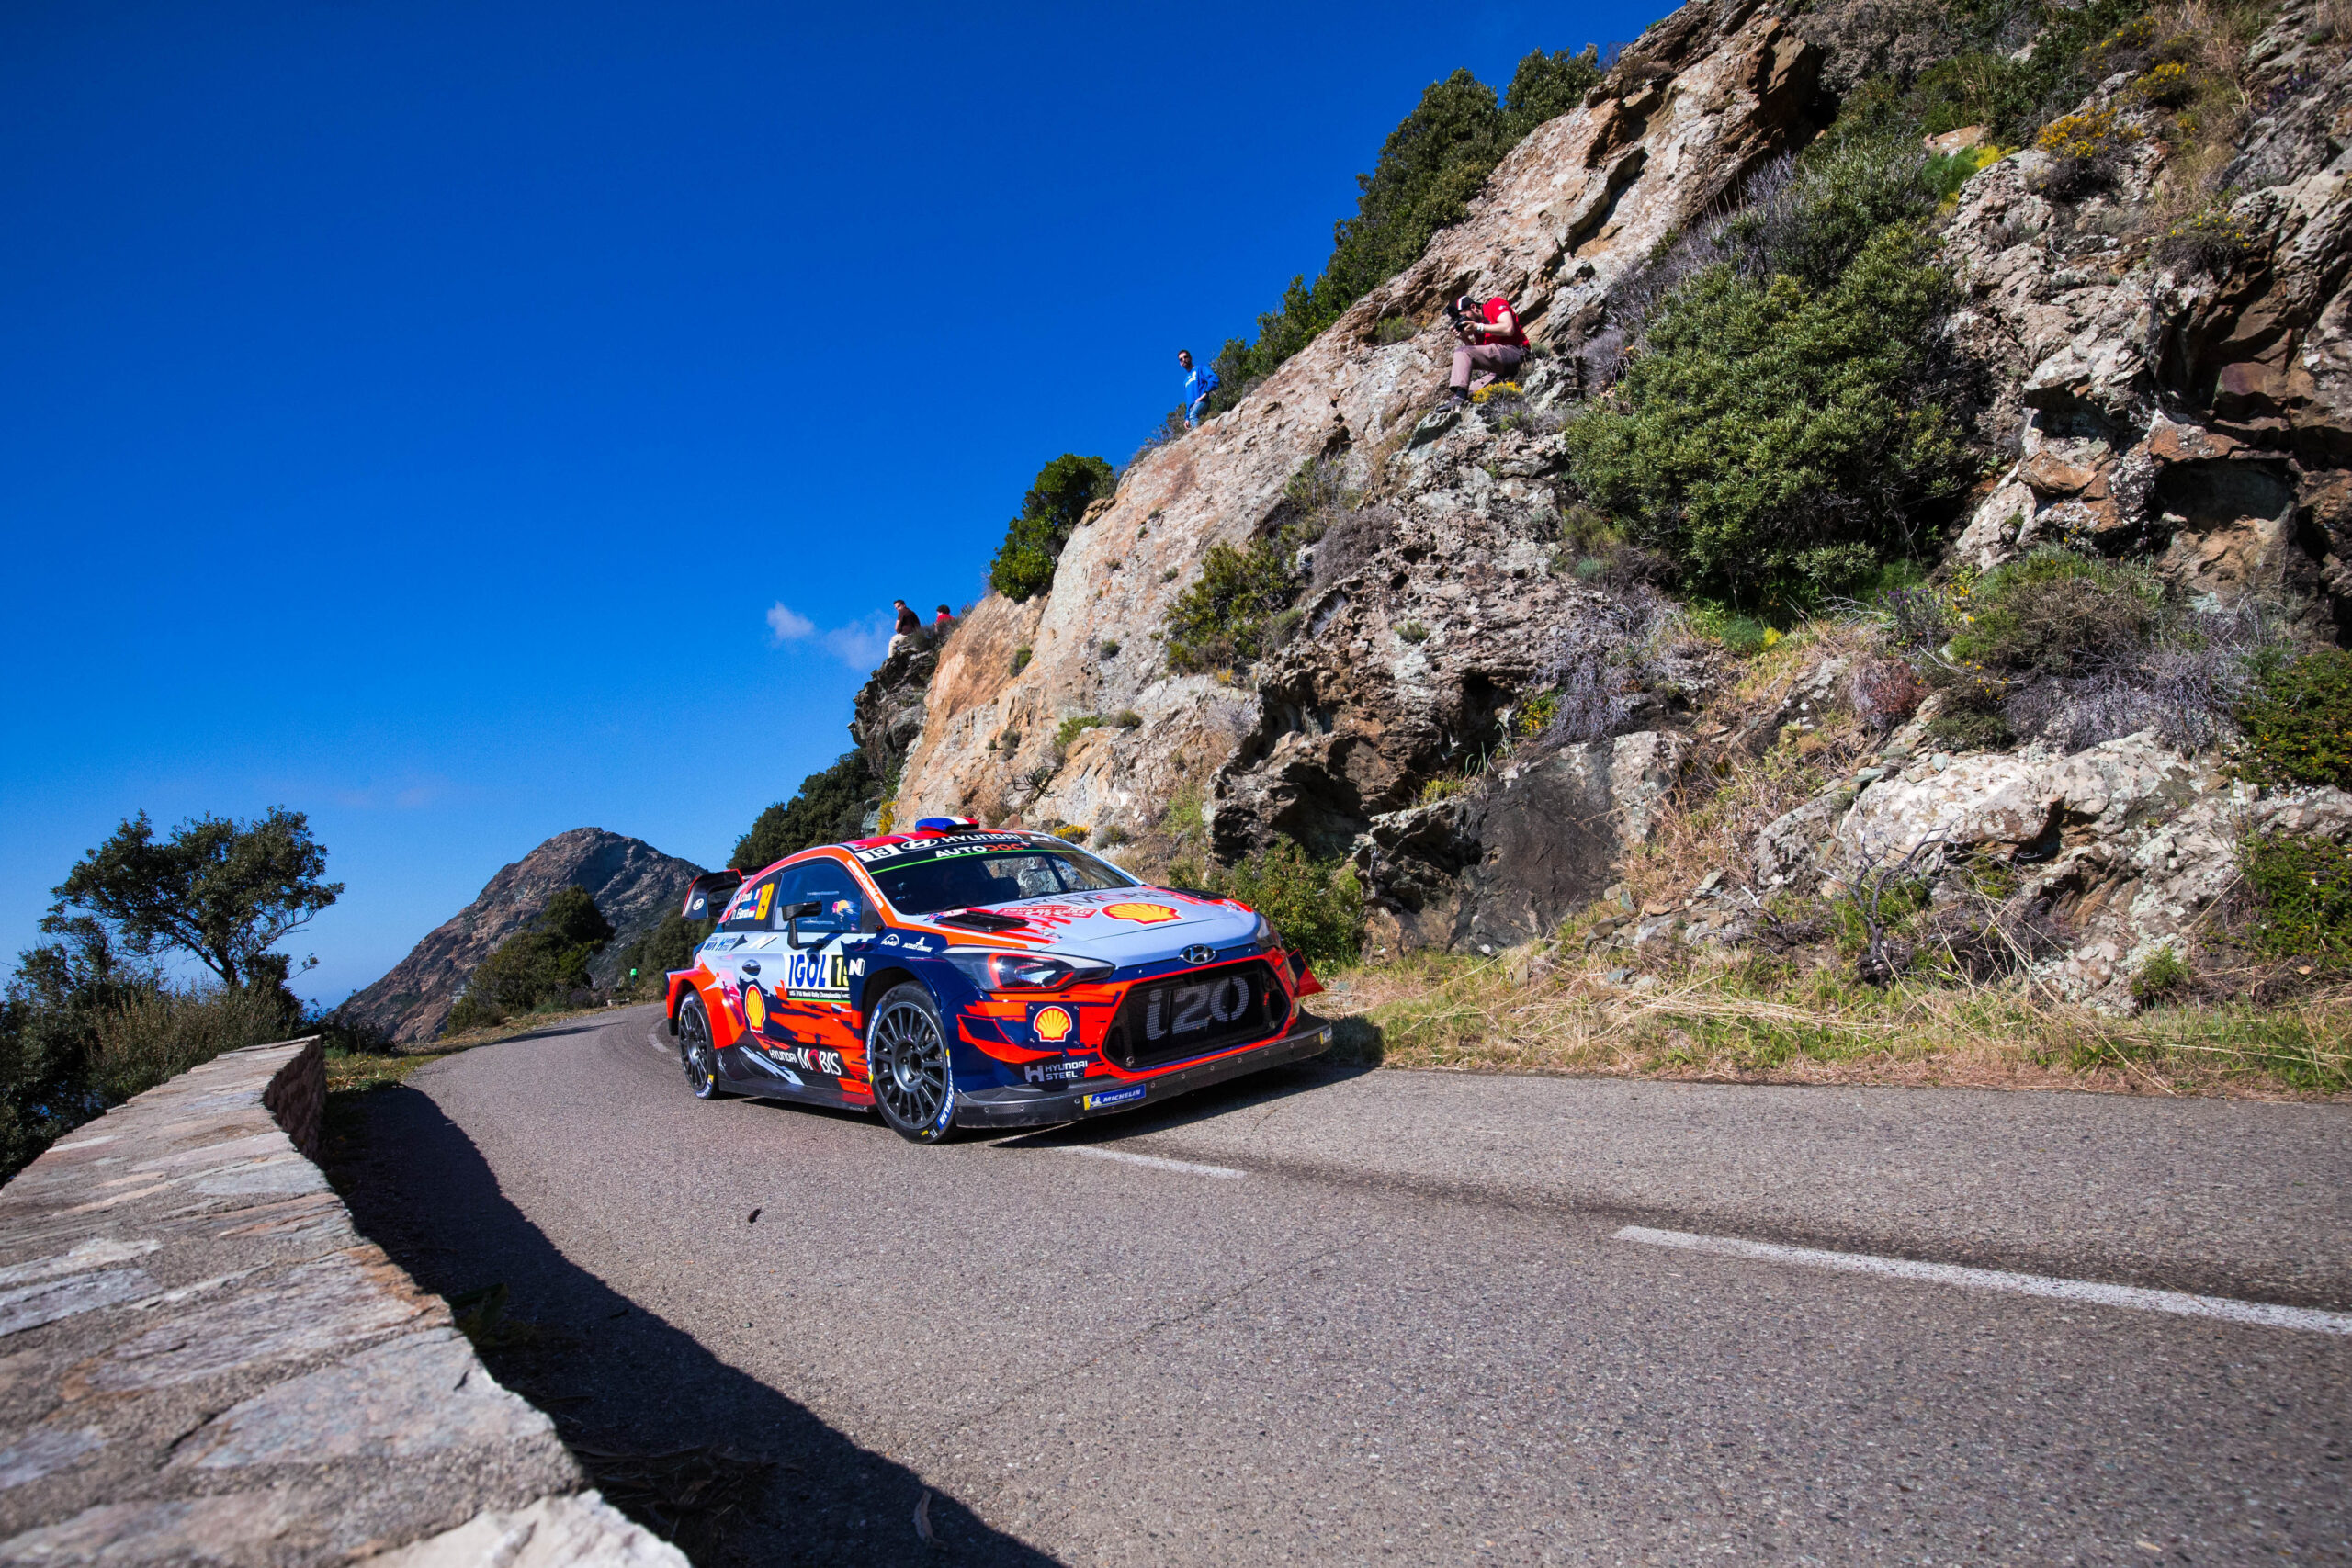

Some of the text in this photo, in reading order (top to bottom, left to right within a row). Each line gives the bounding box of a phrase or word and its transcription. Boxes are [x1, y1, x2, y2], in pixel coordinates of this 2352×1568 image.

[865, 847, 892, 859] 19
[941, 833, 1023, 844] HYUNDAI
[755, 883, 775, 920] 19
[788, 953, 827, 987] IGOL
[769, 1047, 842, 1076] HYUNDAI MOBIS
[1045, 1060, 1088, 1073] HYUNDAI
[1046, 1071, 1078, 1081] STEEL
[939, 1069, 955, 1125] MICHELIN
[1102, 1089, 1141, 1102] MICHELIN
